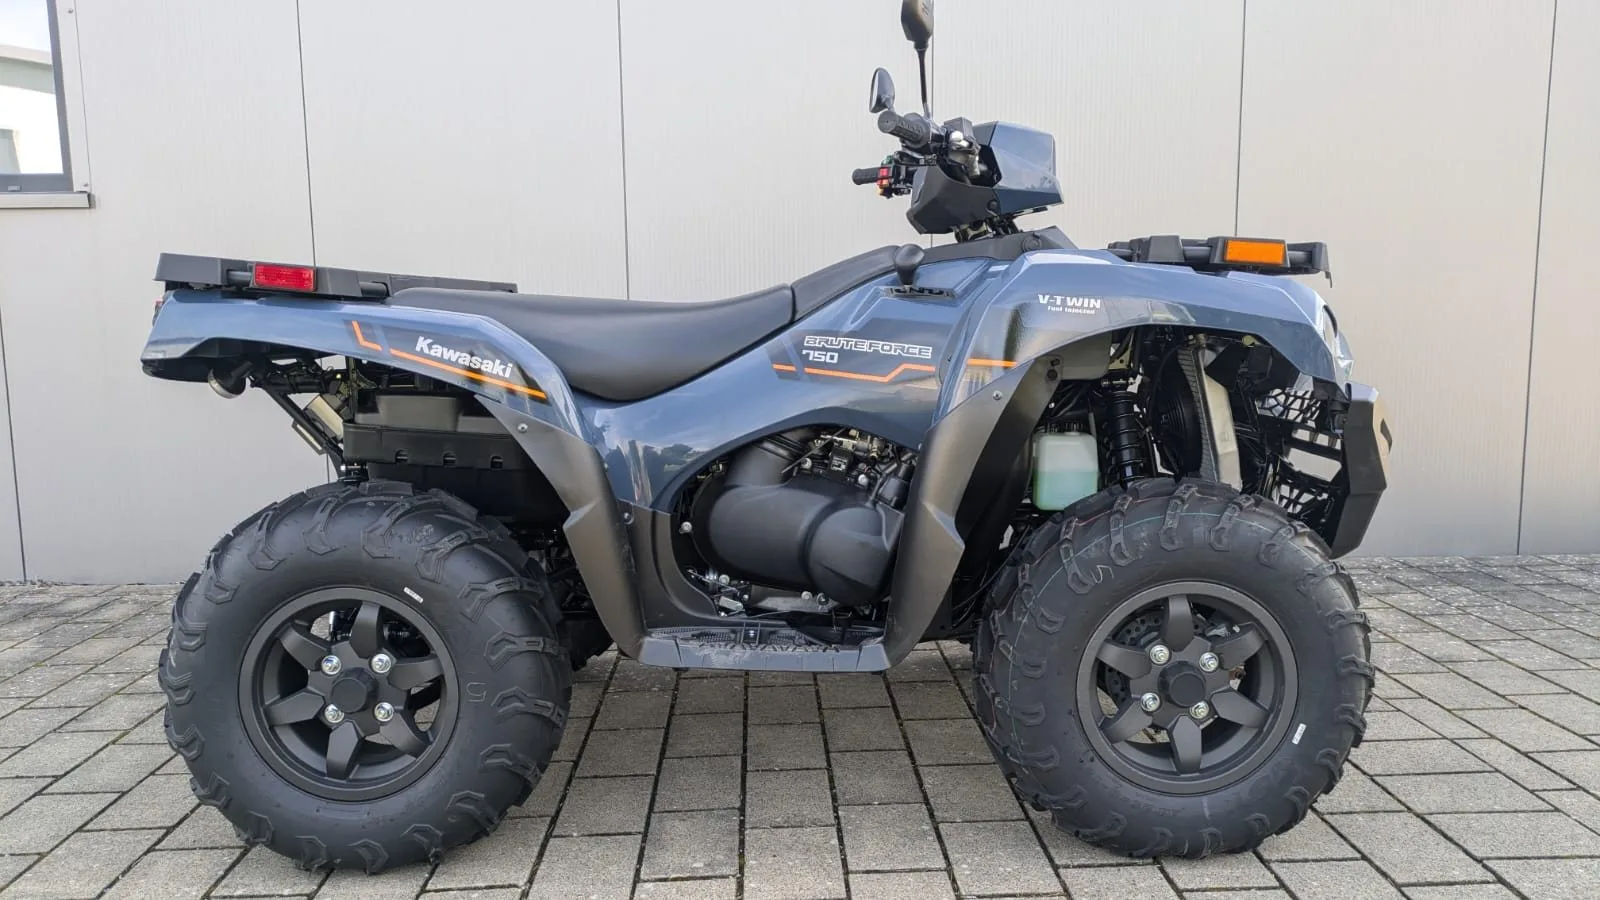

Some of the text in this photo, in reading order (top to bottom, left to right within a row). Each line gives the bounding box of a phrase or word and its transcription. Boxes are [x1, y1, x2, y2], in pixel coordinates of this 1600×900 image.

[1037, 294, 1101, 309] V-TWIN
[415, 335, 513, 378] Kawasaki
[802, 349, 839, 364] 750
